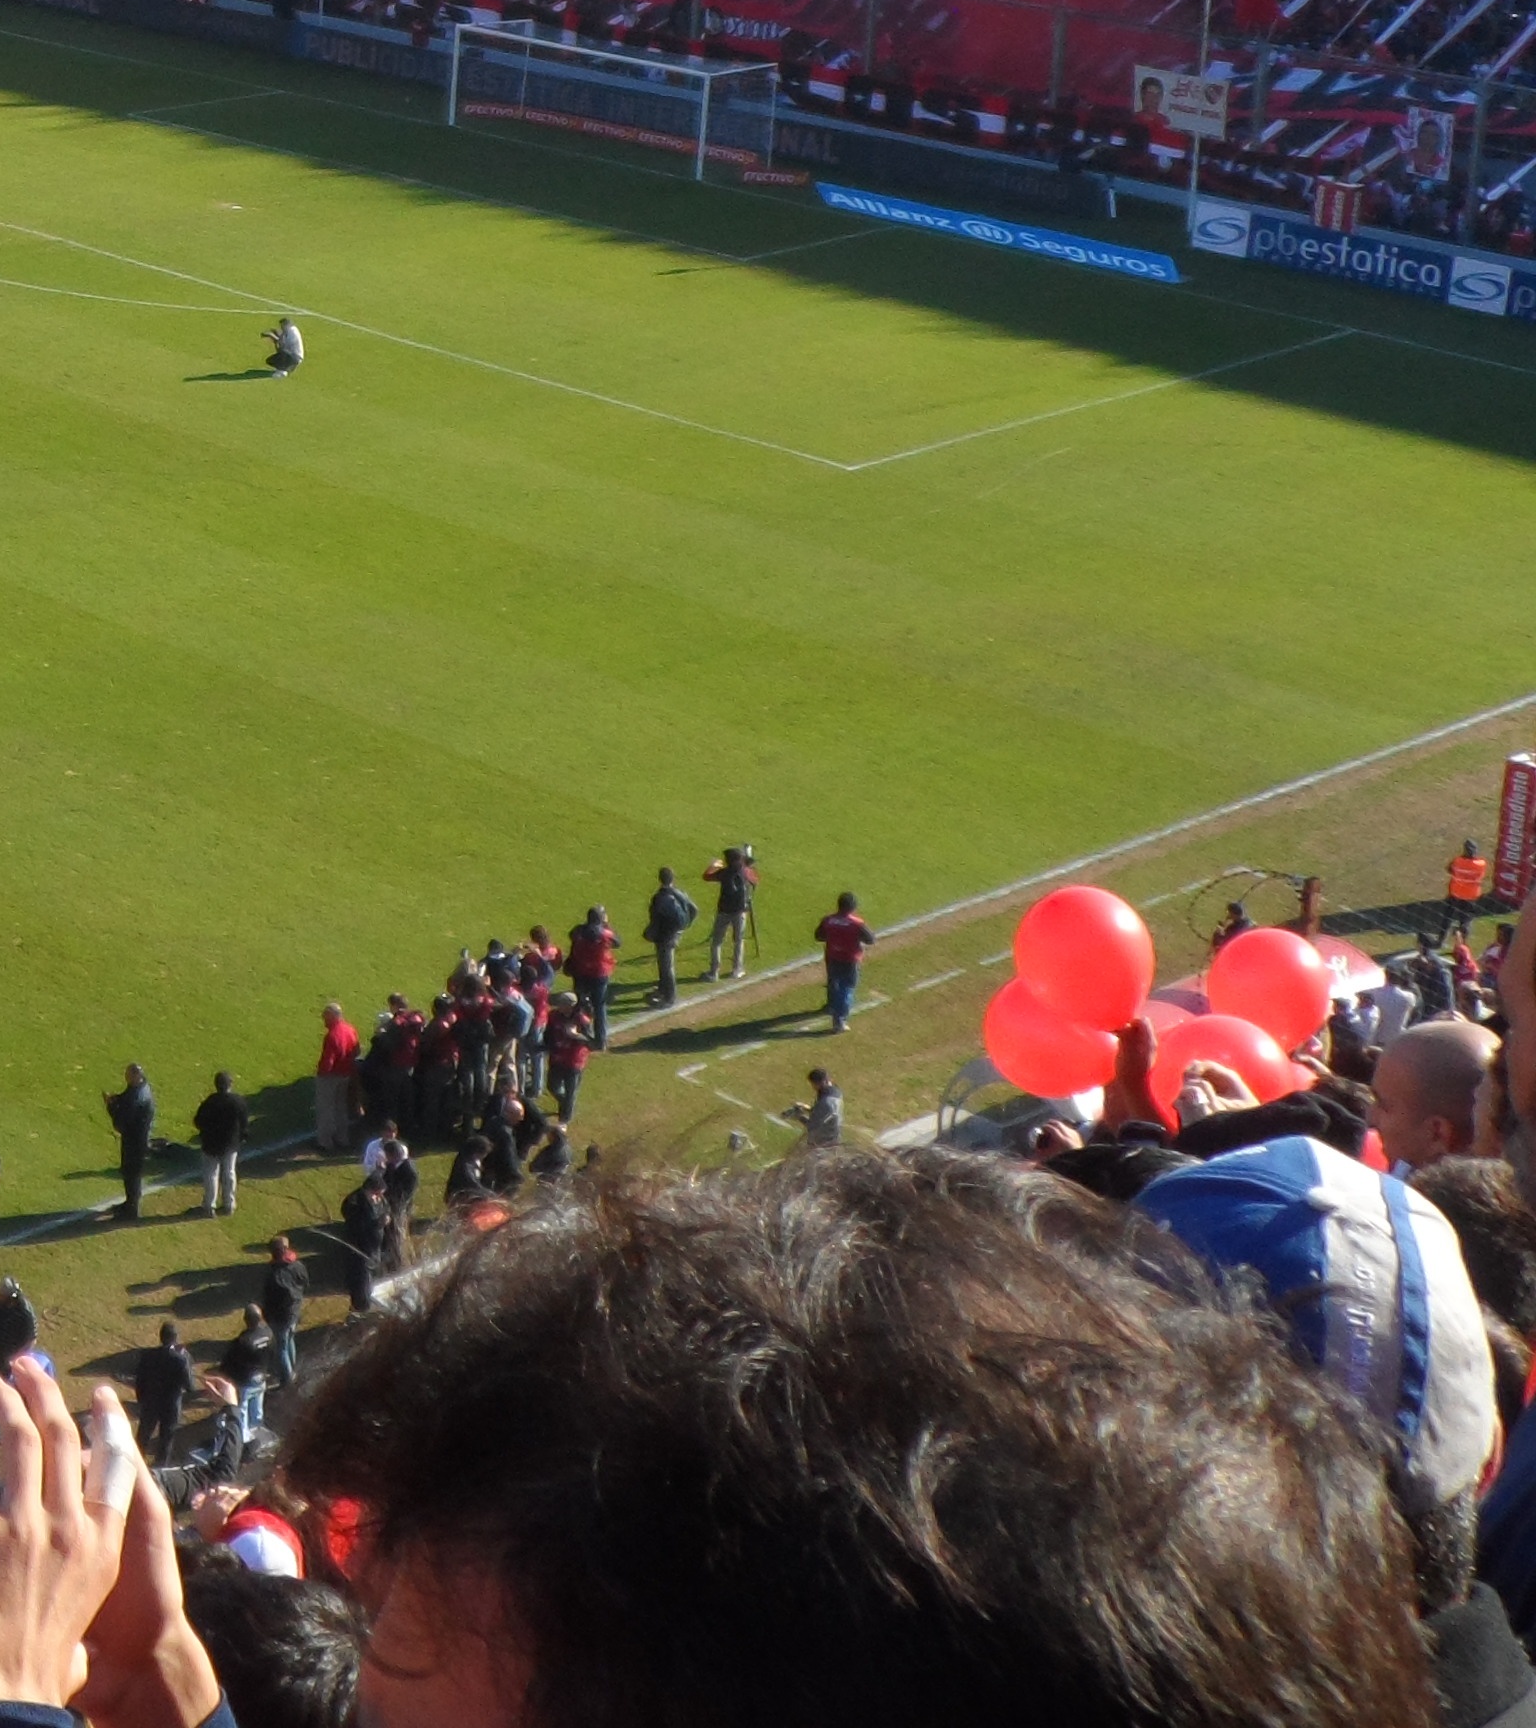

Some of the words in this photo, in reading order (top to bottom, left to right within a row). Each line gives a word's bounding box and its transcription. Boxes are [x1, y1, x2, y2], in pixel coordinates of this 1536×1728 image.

[464, 104, 516, 119] EFECTIVO
[525, 111, 570, 127] EFECTIVO
[637, 131, 684, 149] EFECTIVO
[827, 190, 953, 230] Allianz
[1019, 231, 1168, 280] Seguros
[1252, 223, 1443, 289] pbestatica
